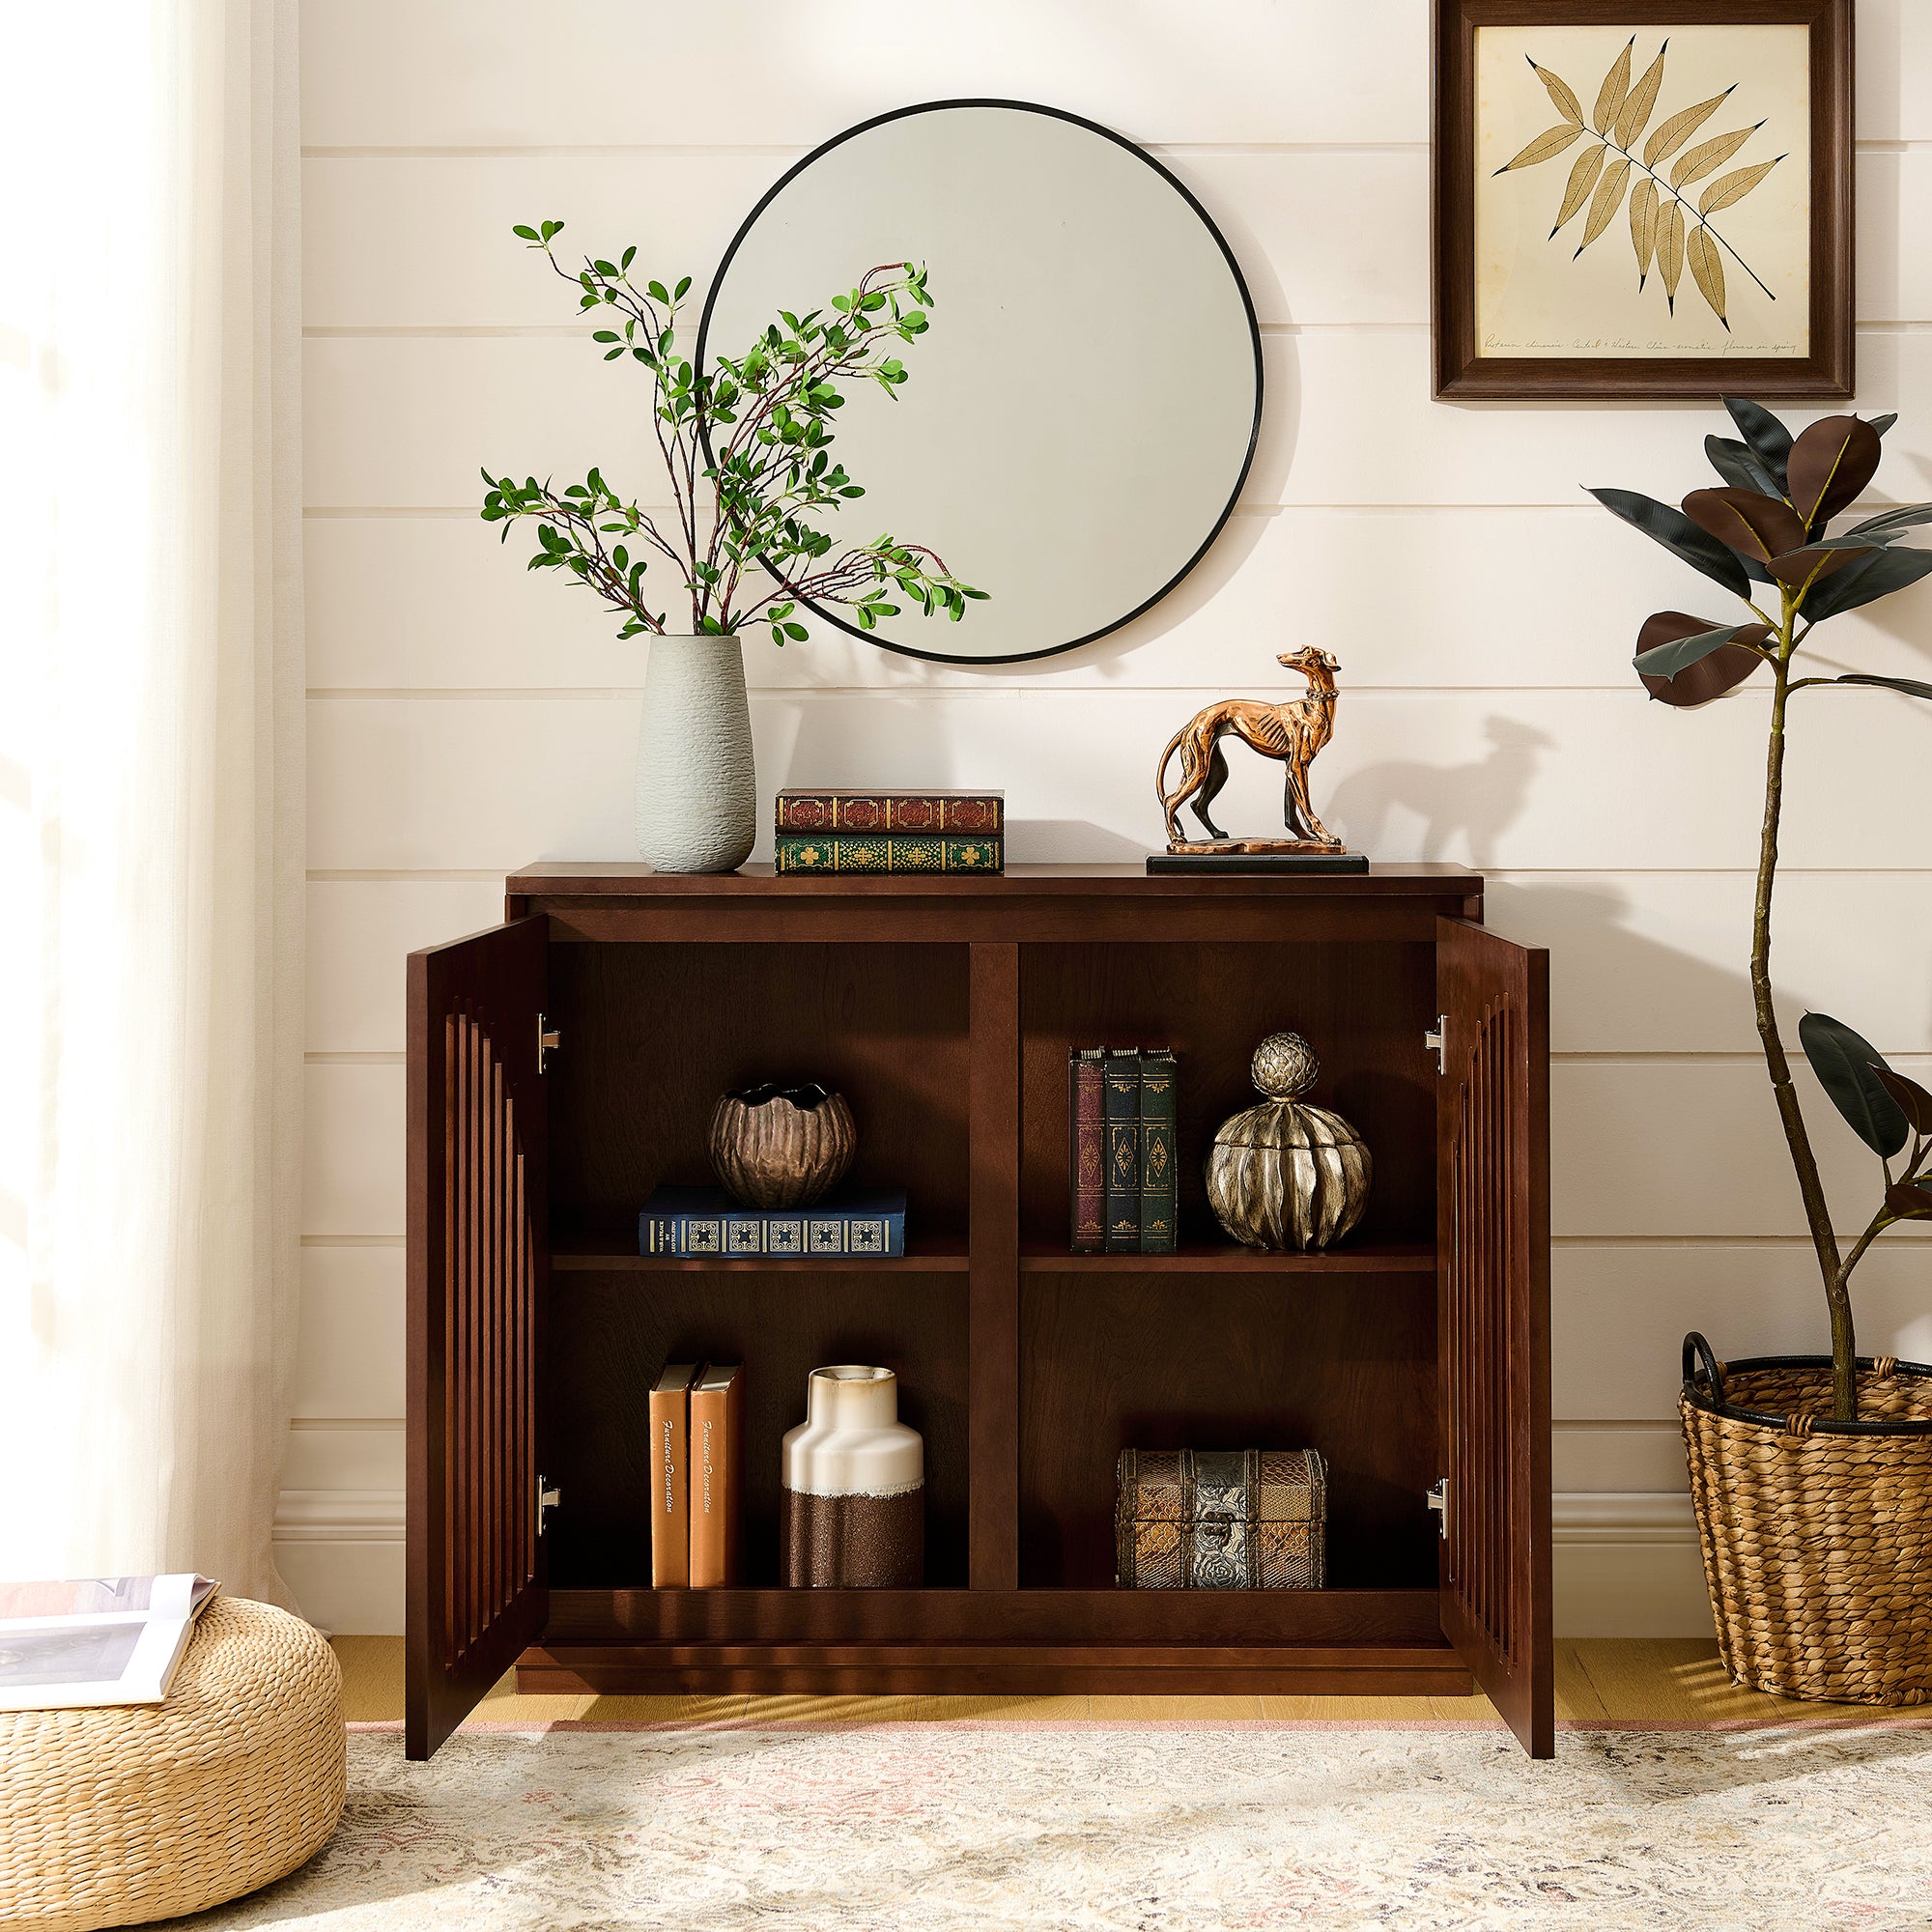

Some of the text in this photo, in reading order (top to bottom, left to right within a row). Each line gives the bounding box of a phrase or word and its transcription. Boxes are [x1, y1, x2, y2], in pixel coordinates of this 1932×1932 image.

[662, 1420, 675, 1514] Furniture Decoration
[701, 1420, 713, 1514] Furniture Decoration
